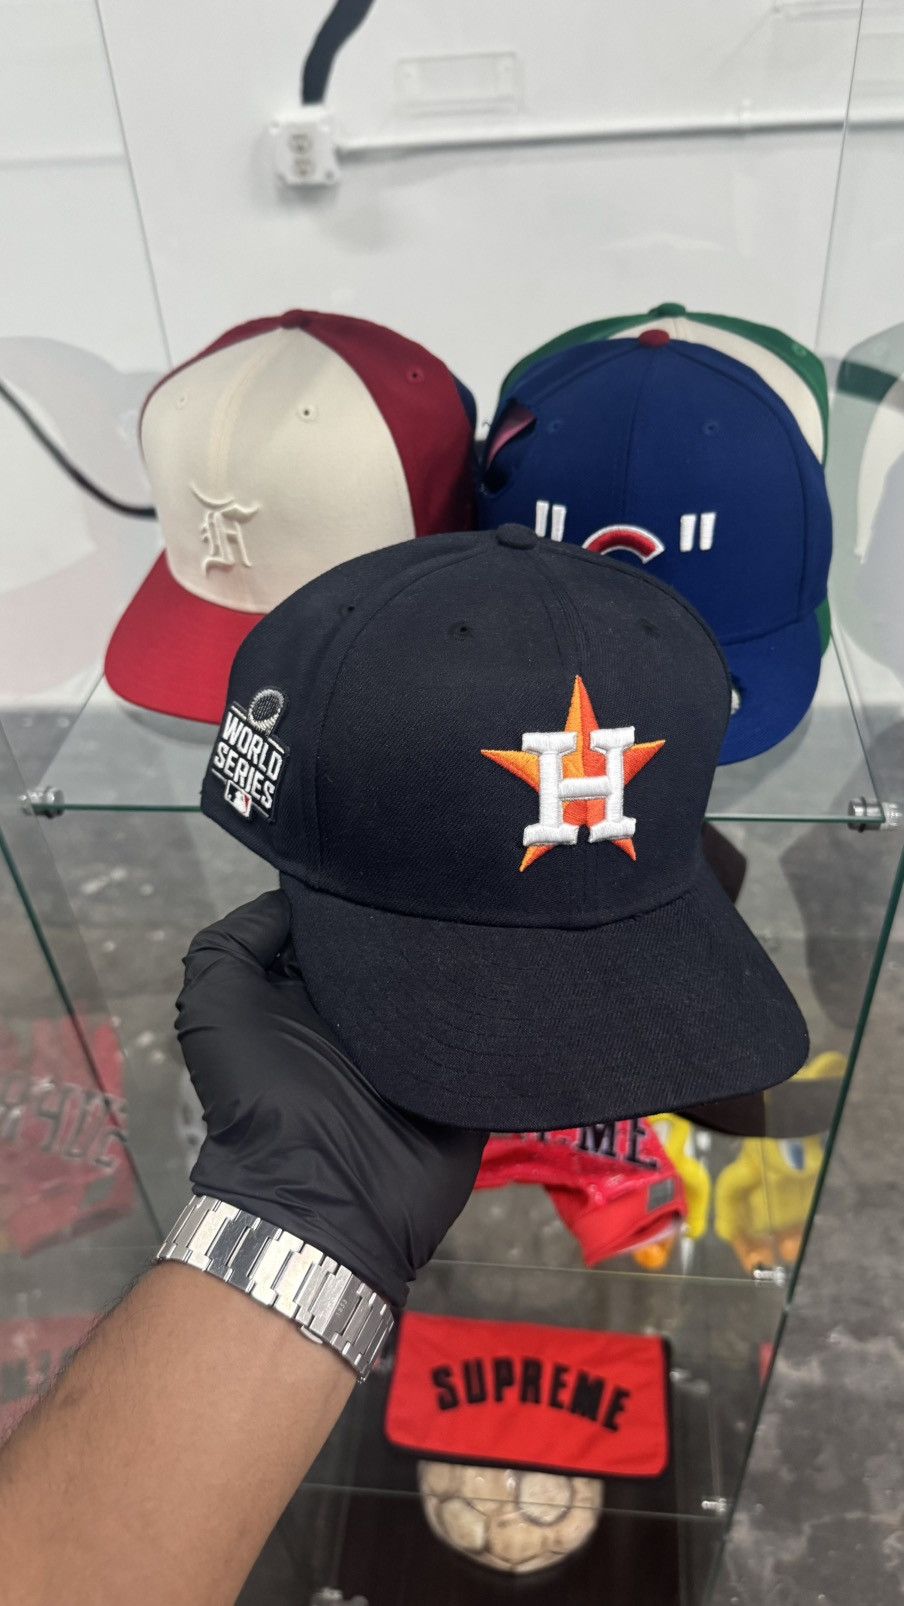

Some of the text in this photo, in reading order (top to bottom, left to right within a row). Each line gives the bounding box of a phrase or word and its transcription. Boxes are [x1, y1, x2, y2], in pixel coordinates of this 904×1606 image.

[213, 741, 275, 809] SERIES
[222, 711, 282, 781] WORLD
[521, 726, 637, 845] H
[431, 1356, 631, 1433] SUPREME
